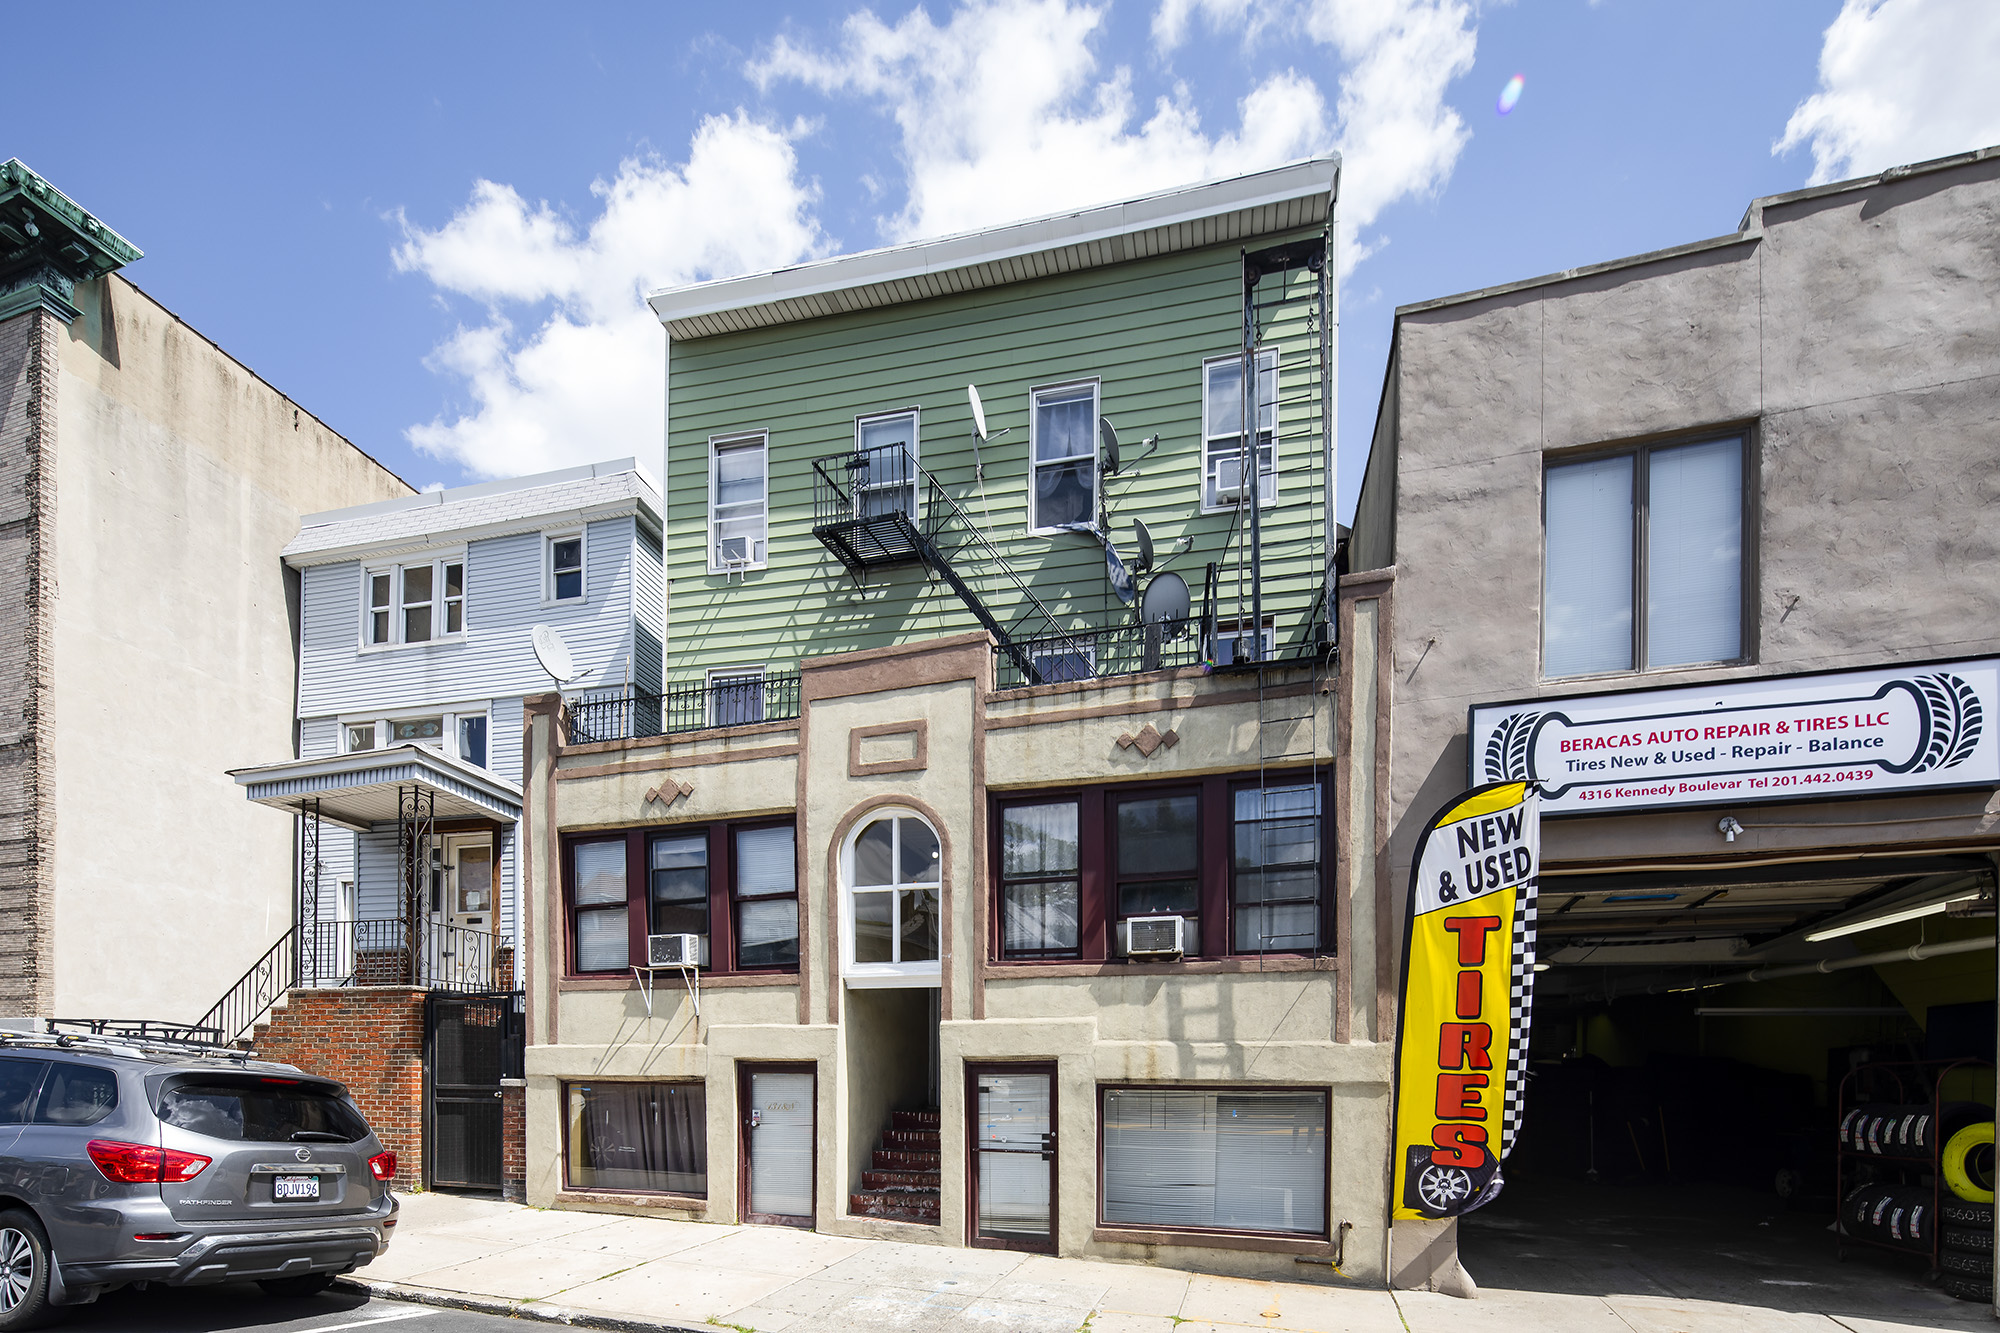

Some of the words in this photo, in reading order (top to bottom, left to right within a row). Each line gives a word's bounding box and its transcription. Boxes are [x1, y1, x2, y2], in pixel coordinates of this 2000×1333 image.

[1560, 733, 1642, 753] BERACAS
[1647, 728, 1699, 745] AUTO
[1704, 722, 1771, 740] REPAIR
[1775, 721, 1790, 734] &
[1794, 715, 1849, 733] TIRES
[1854, 711, 1890, 728] LLC
[1565, 759, 1606, 772] Tires
[1611, 756, 1649, 769] New
[1653, 752, 1667, 765] &
[1672, 747, 1716, 763] Used
[1732, 741, 1792, 760] Repair
[1808, 737, 1884, 753] Balance
[1579, 789, 1612, 801] 4316
[1615, 784, 1676, 799] Kennedy
[1679, 780, 1742, 793] Boulevar
[1748, 777, 1768, 789] Tel
[1771, 769, 1874, 787] 201.442.0439
[1456, 806, 1525, 859] NEW
[1438, 870, 1459, 903] &
[1465, 846, 1532, 894] USED
[1430, 915, 1502, 1169] TIRES
[276, 1183, 318, 1196] 8DJV196
